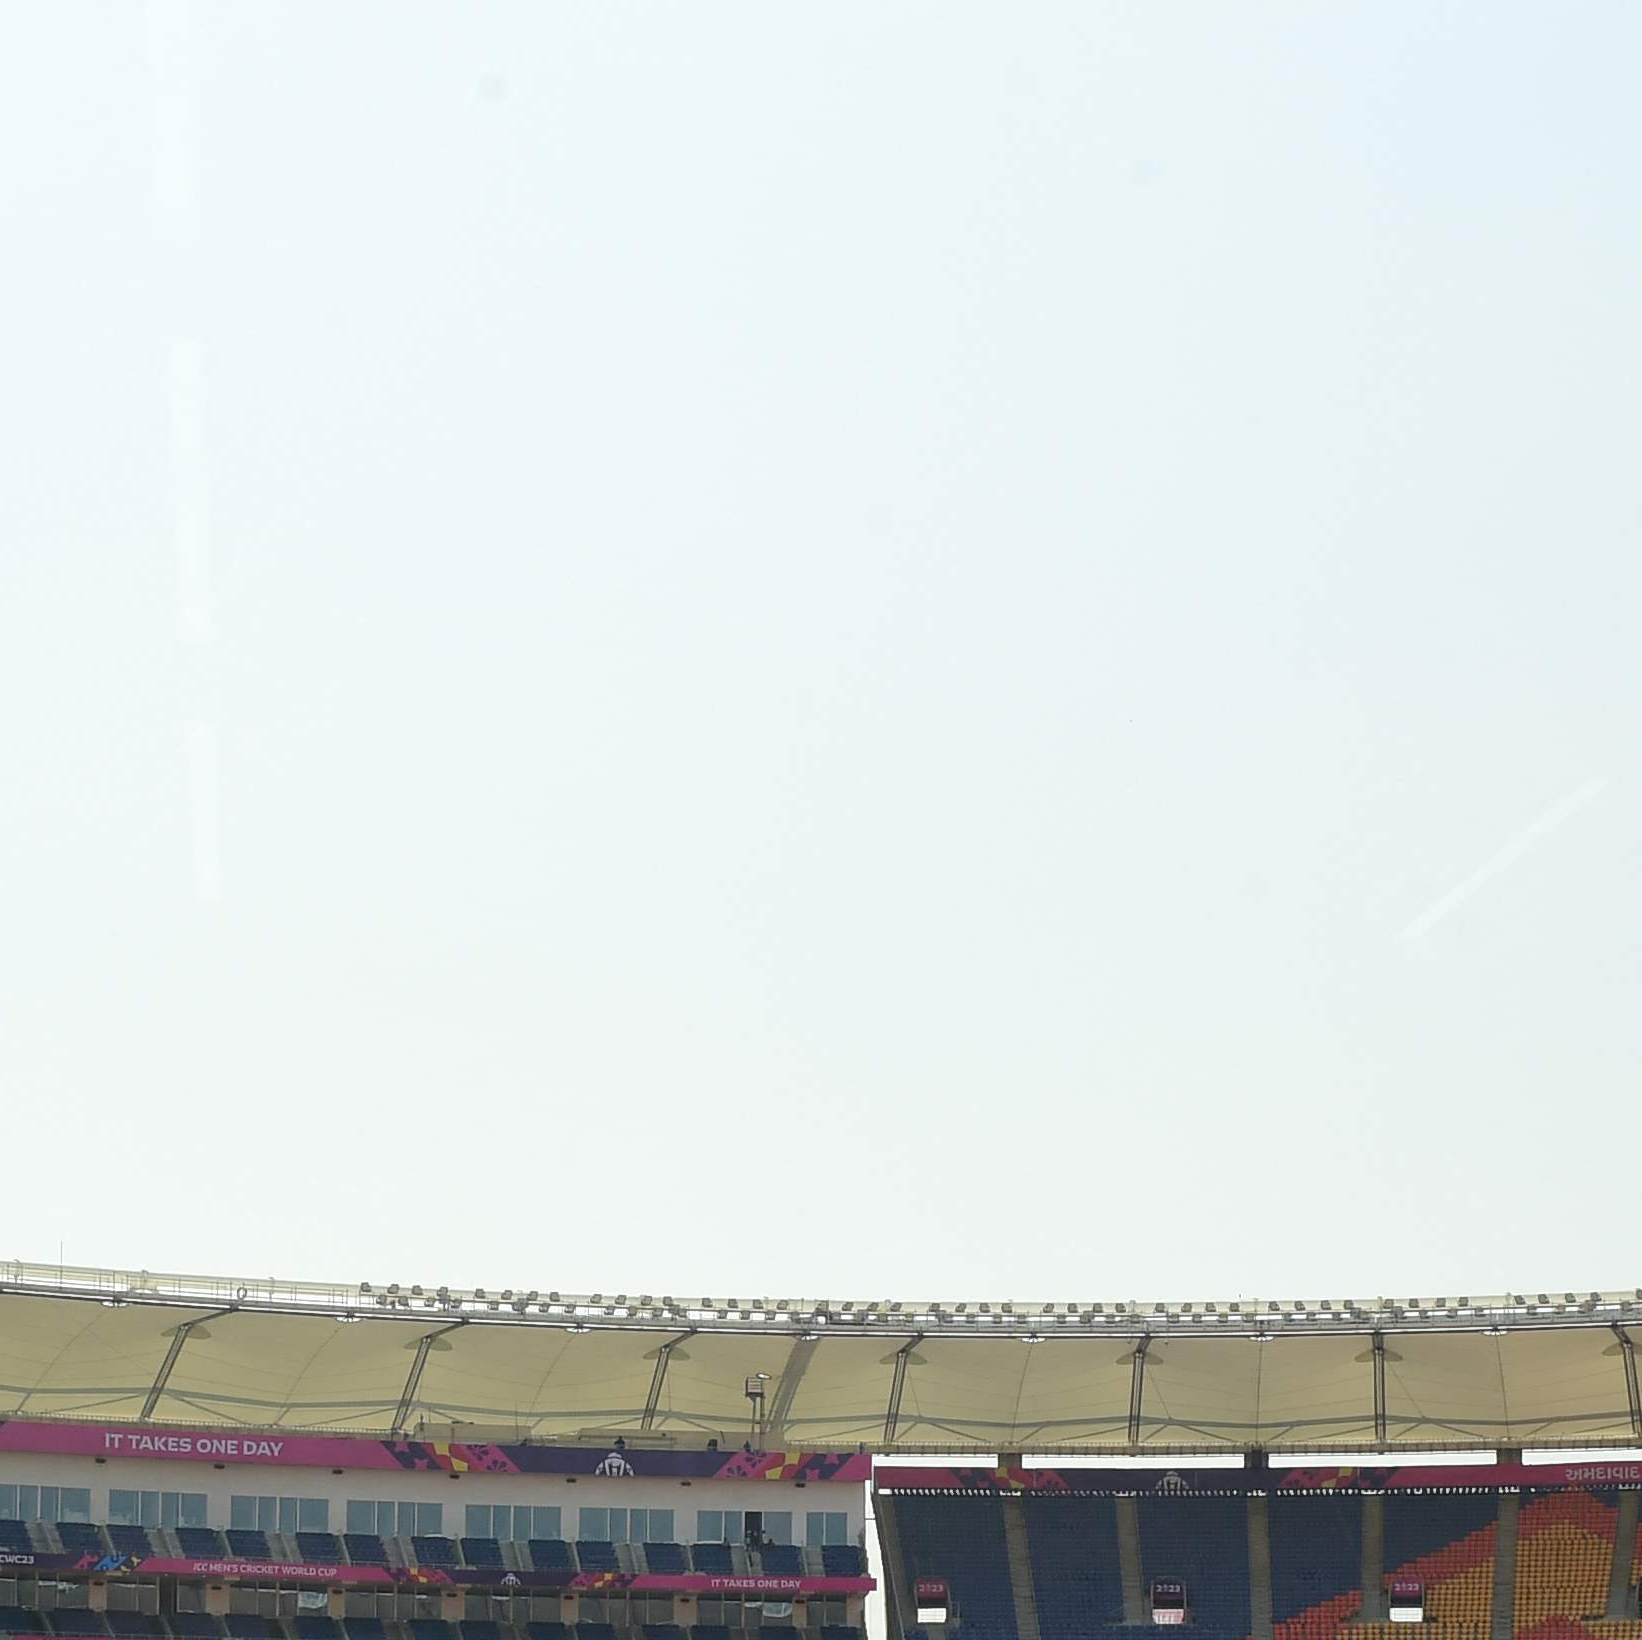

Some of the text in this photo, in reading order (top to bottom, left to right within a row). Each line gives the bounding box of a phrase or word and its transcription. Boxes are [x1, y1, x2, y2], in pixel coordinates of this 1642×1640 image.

[104, 1433, 284, 1457] IT TAKES ONE DAY
[193, 1563, 336, 1577] ICC MEN'S CRICKET WORLD CUP
[711, 1579, 801, 1588] IT TAKES ONE DAY
